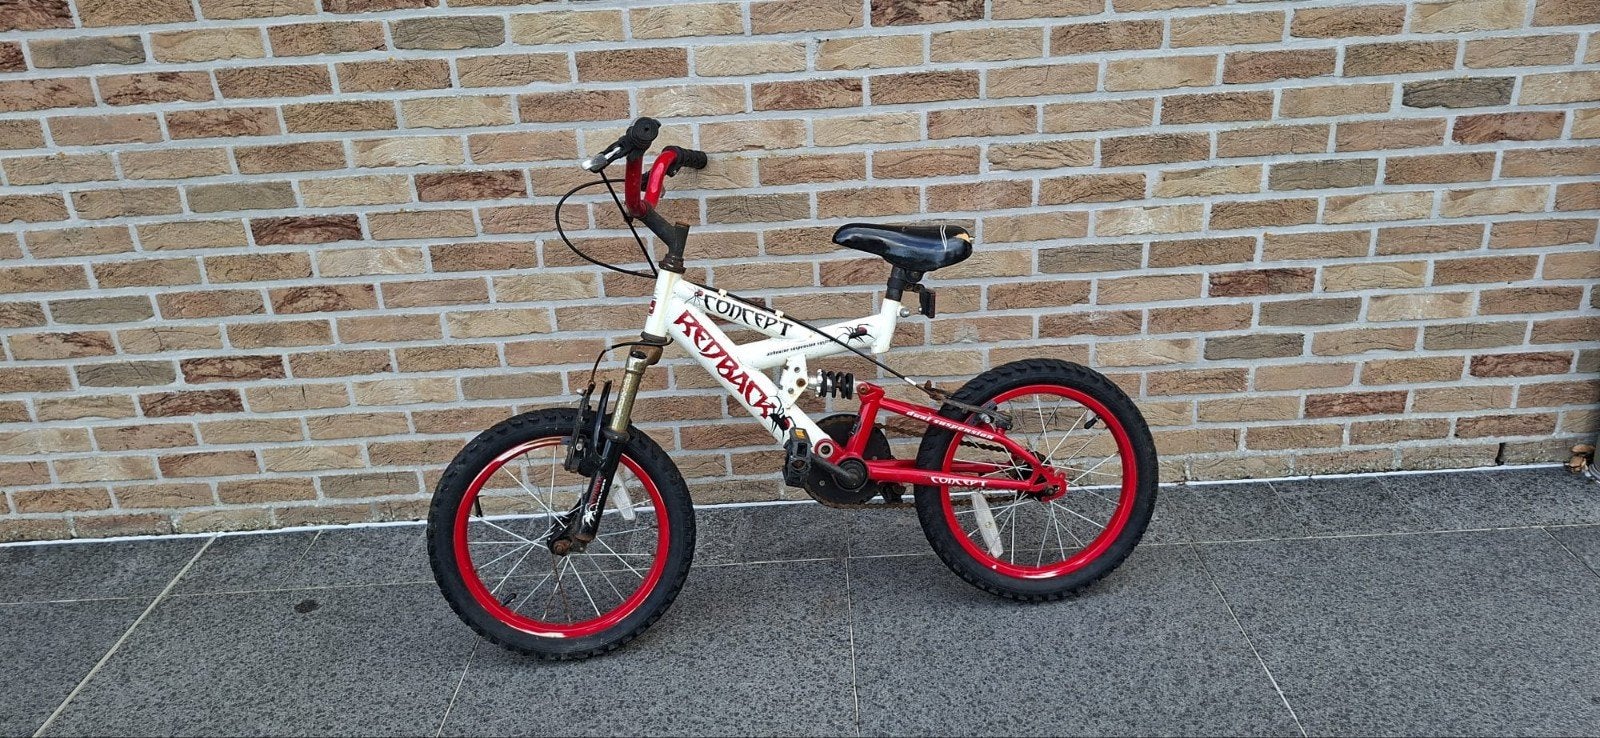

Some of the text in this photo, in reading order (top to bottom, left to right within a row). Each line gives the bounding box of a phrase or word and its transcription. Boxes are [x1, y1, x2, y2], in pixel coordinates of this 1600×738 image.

[704, 294, 793, 337] CONCEPT
[674, 309, 776, 419] REDBACK
[906, 411, 995, 440] dual suspension
[930, 476, 989, 487] CONCEPT
